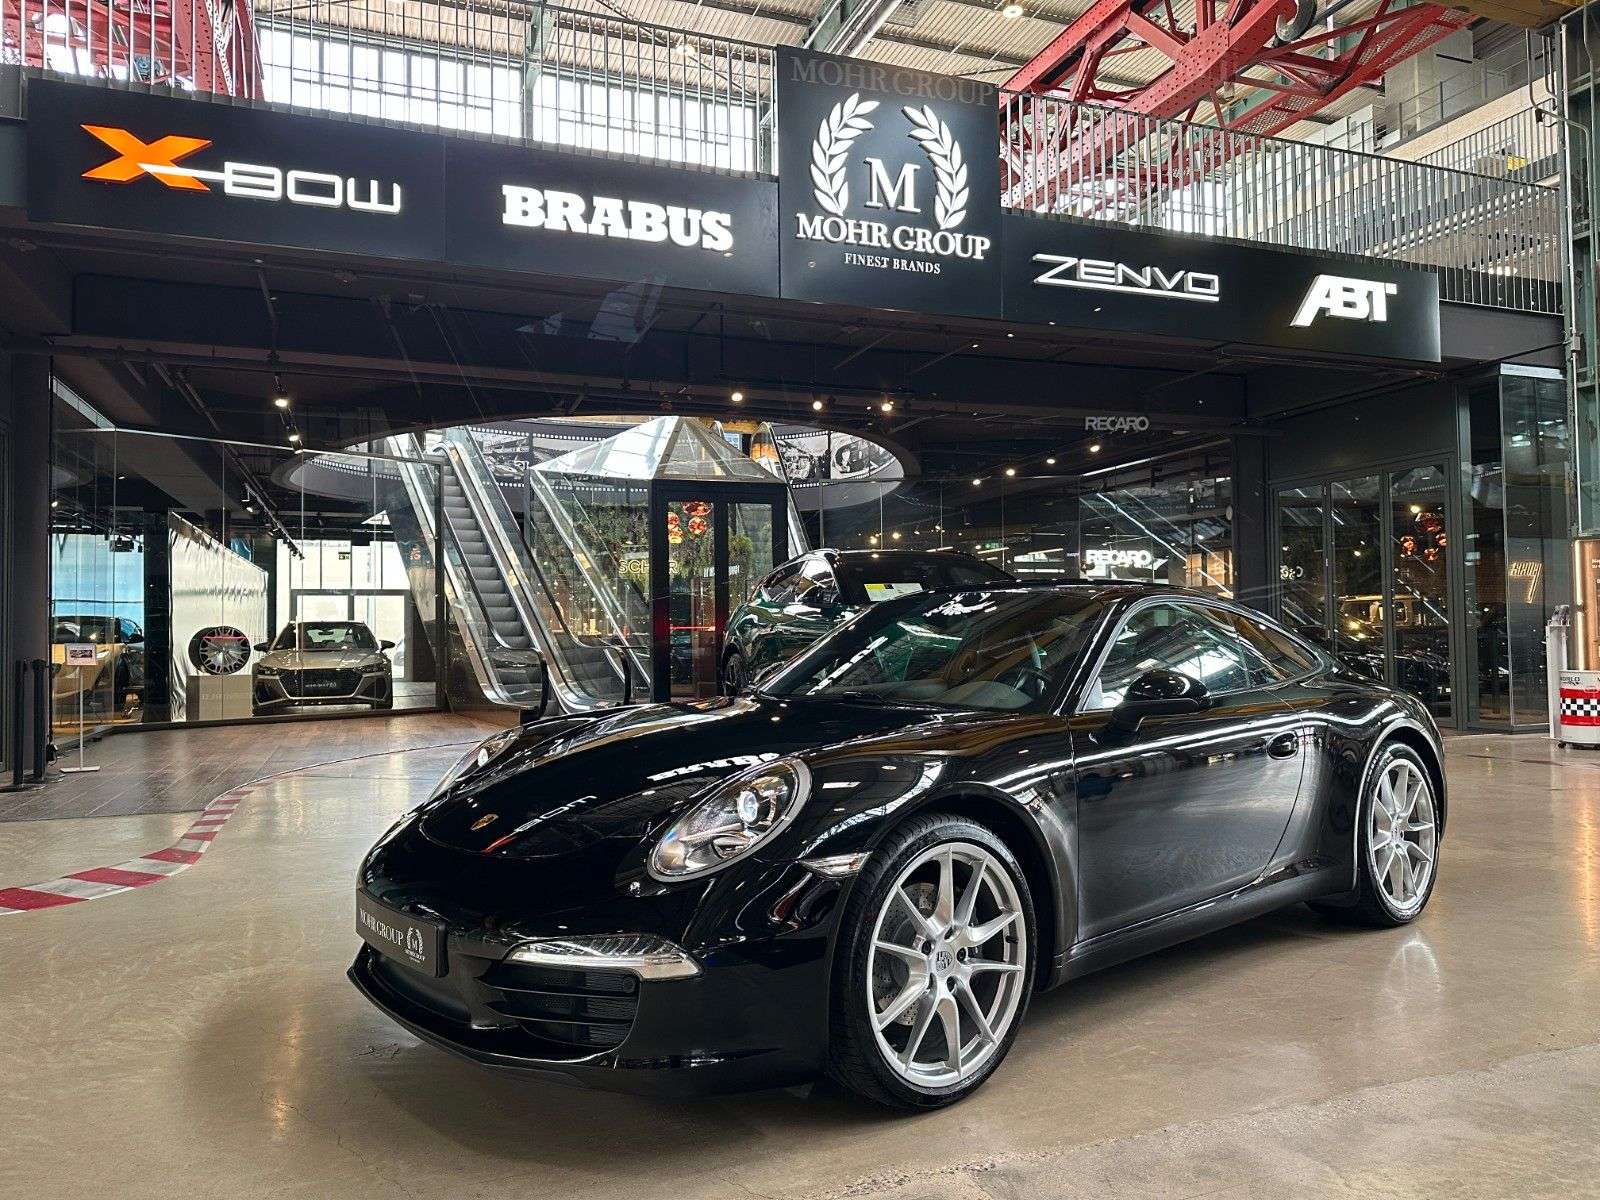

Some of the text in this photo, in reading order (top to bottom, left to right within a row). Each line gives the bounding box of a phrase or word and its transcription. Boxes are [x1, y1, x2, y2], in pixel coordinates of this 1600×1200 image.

[790, 56, 995, 107] MOHR GROUP
[863, 157, 921, 213] M
[502, 185, 734, 251] BRABUS
[795, 212, 991, 260] MOHR GROUP
[844, 252, 941, 274] FINEST BRANDS
[1033, 253, 1220, 302] ZENVO
[1289, 274, 1398, 327] ABT
[1084, 415, 1151, 432] RECARO
[1086, 549, 1153, 565] RECARO
[376, 921, 404, 945] GROUP
